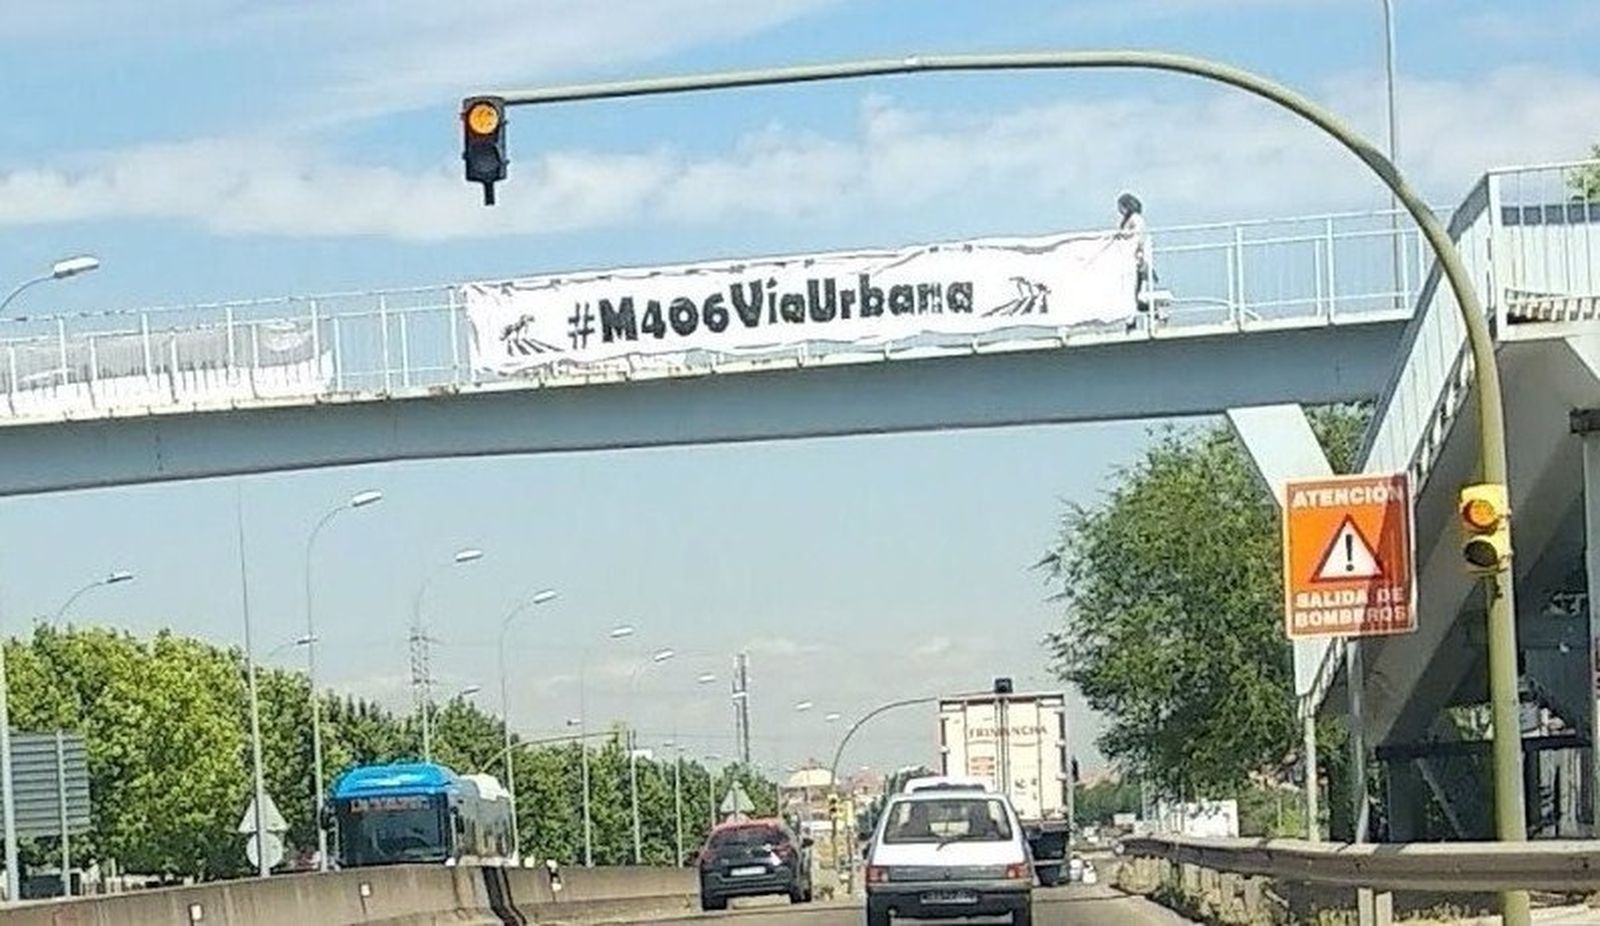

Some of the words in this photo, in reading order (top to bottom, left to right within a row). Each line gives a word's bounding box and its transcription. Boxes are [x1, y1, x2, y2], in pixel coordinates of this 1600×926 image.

[567, 273, 974, 350] #M406VíaUrbana
[1292, 482, 1404, 508] ATENCIÓN
[1296, 588, 1368, 608] SALIDA
[1376, 586, 1405, 603] DE
[1294, 605, 1406, 628] BOMBEROS
